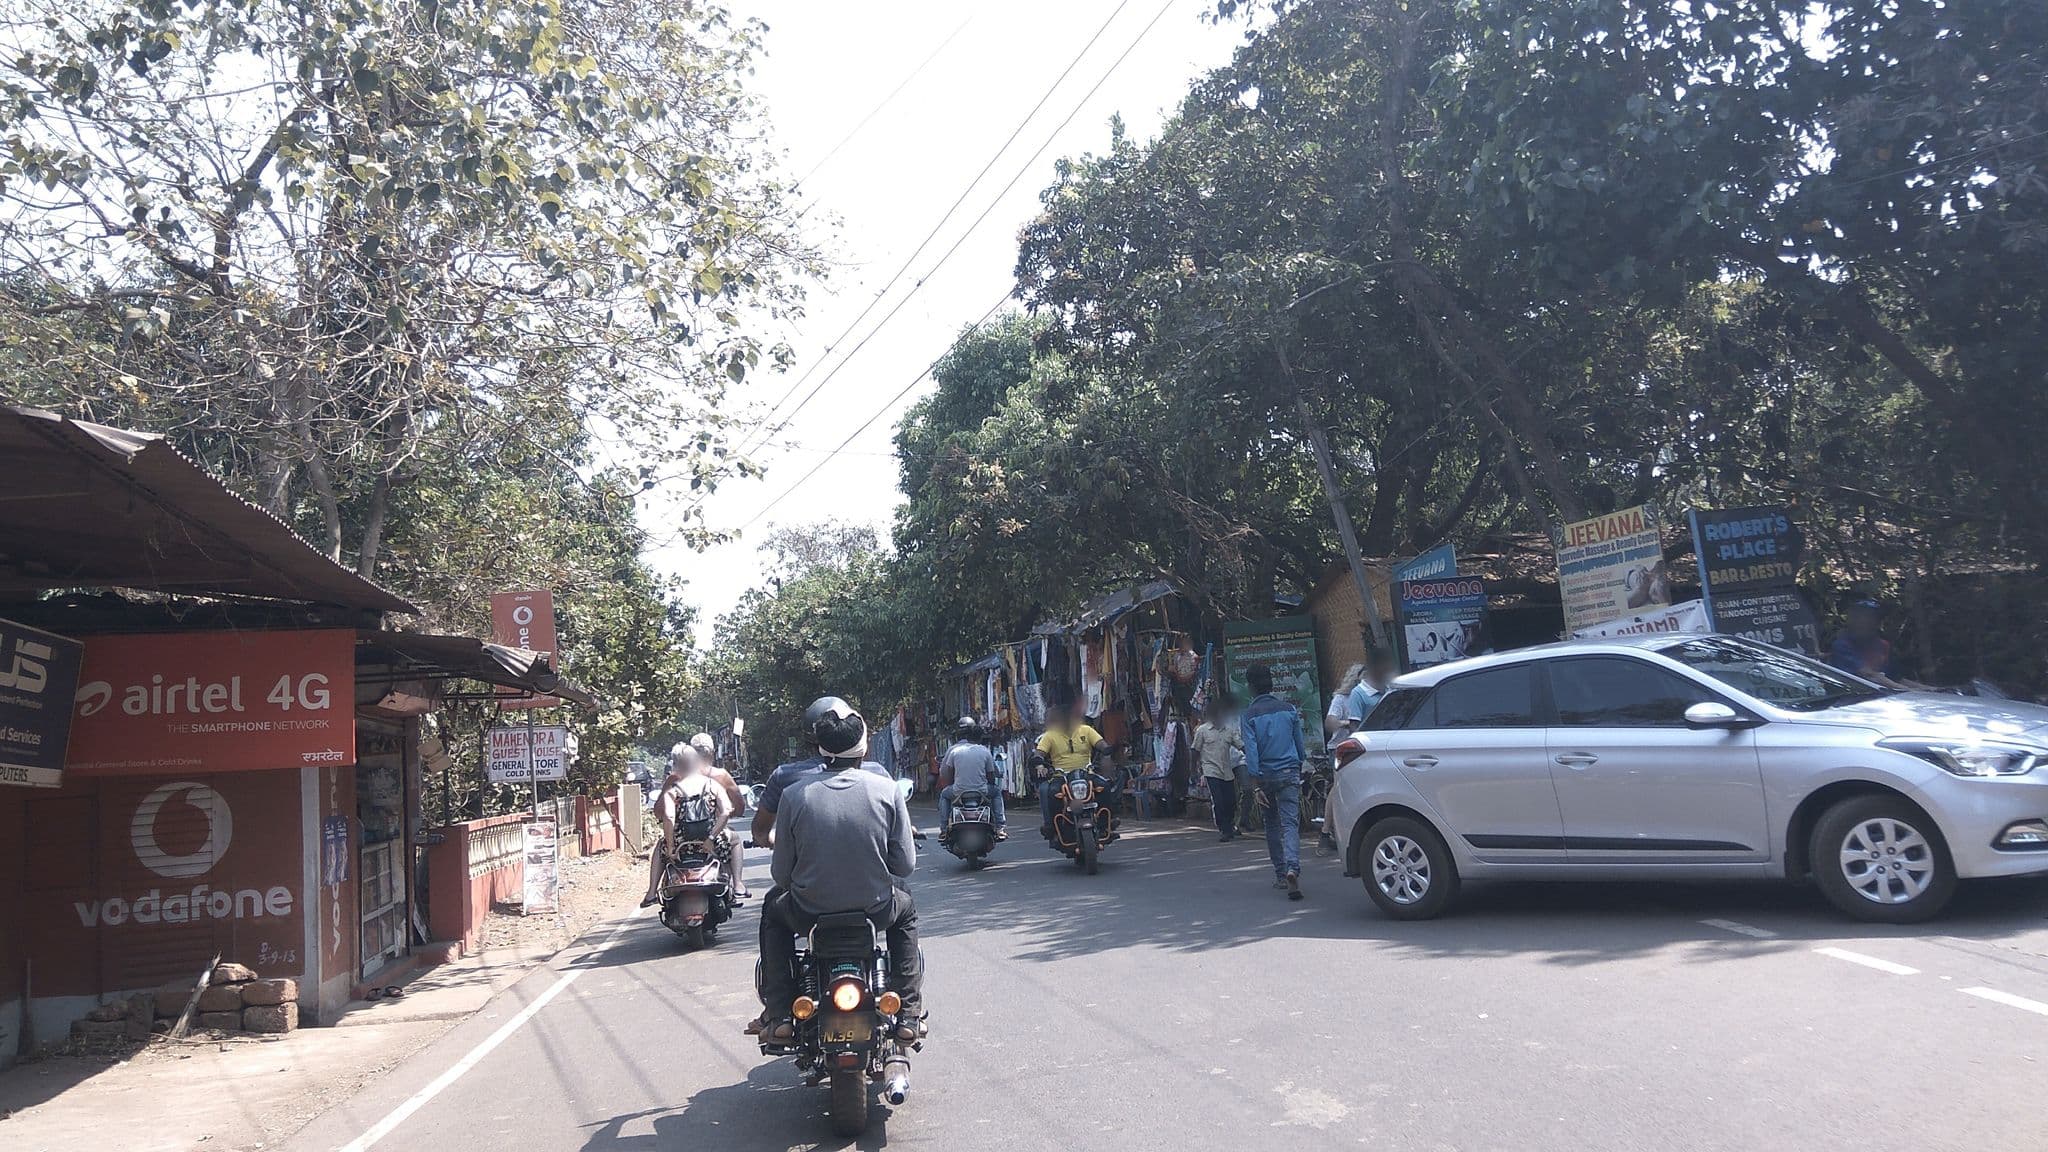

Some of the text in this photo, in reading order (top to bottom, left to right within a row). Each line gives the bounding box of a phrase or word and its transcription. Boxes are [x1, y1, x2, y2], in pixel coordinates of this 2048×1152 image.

[1567, 511, 1645, 547] JEEVANA
[1704, 512, 1789, 541] ROBERT'S
[1719, 539, 1777, 561] PLACE
[1709, 567, 1739, 586] BAR
[1749, 561, 1794, 582] RESTO
[1403, 580, 1484, 601] Jeevana
[1751, 613, 1788, 625] CUISINE
[122, 672, 330, 715] airtel 4G
[7, 727, 42, 745] Services
[168, 719, 330, 734] THE SMARTPHONE NETWORK
[492, 746, 562, 760] GUEST OUSE
[491, 758, 559, 771] GENERAL TORE
[505, 769, 552, 778] COLD DINKS
[75, 883, 293, 928] vodafone
